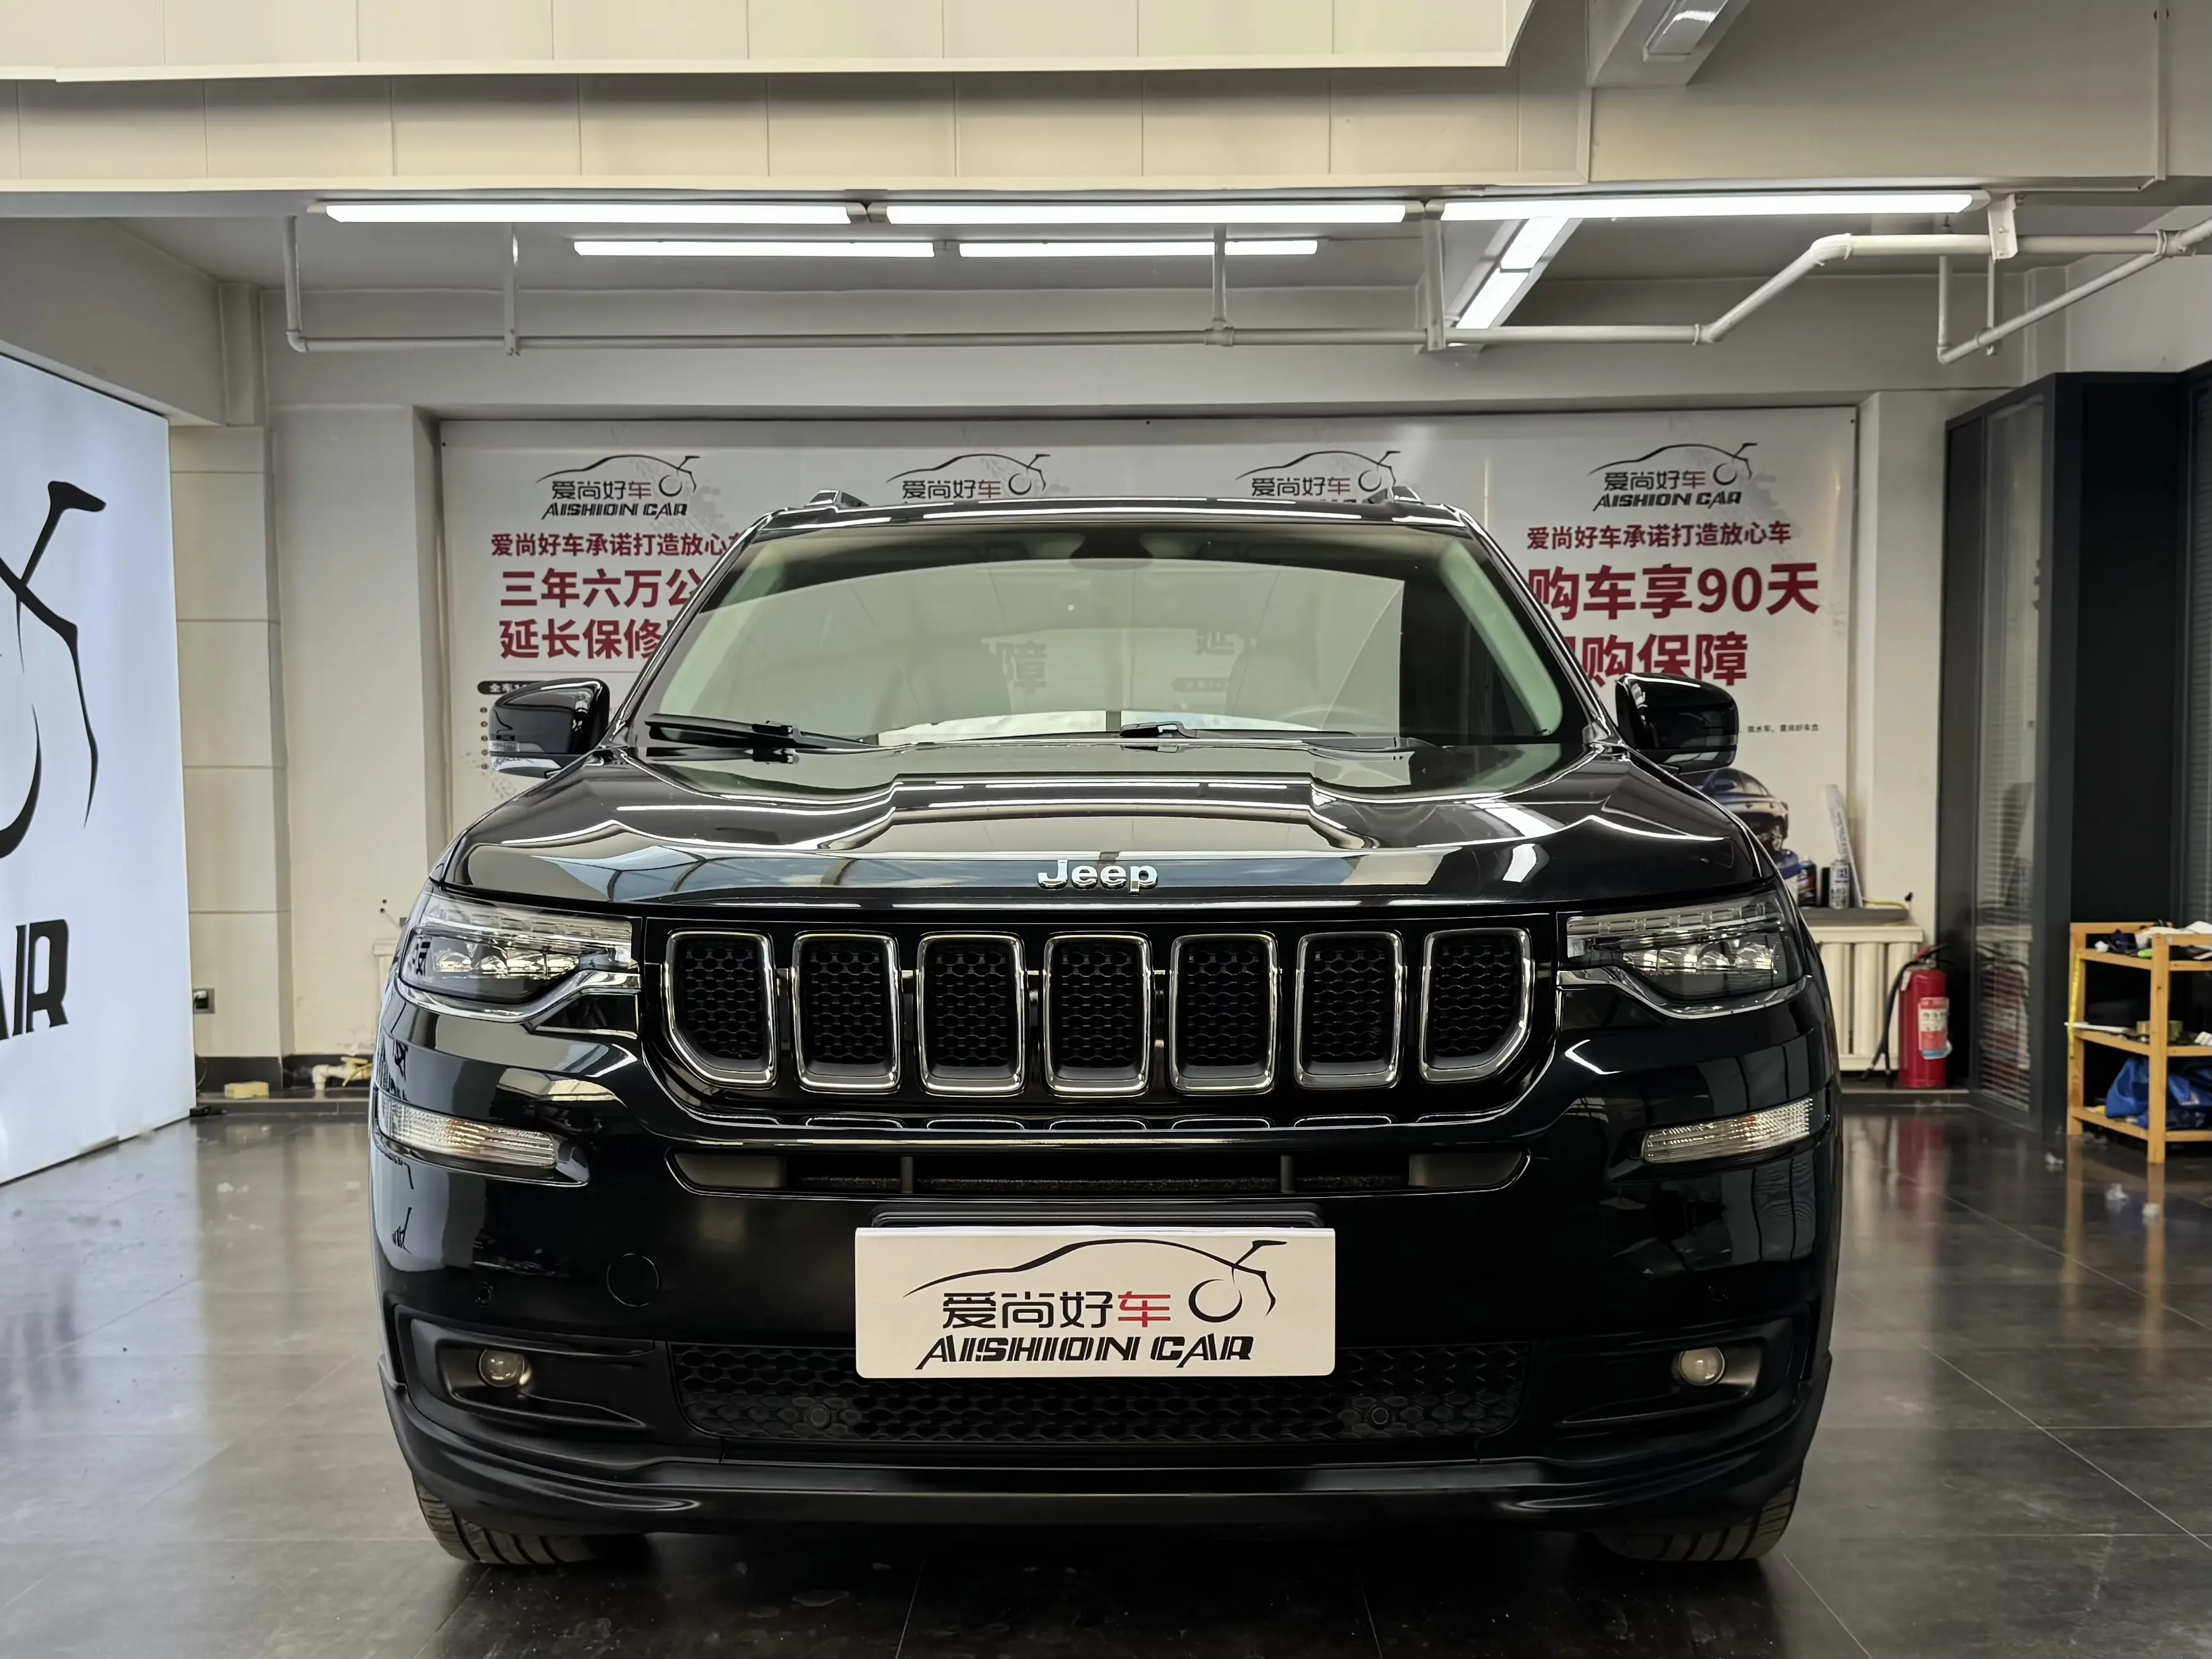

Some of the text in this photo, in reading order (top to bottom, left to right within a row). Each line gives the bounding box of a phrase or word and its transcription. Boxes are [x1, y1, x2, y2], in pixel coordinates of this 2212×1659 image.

[552, 480, 652, 500] 爱尚好车
[902, 479, 1001, 499] 爱尚好车
[1252, 477, 1351, 496] 爱尚好车
[1604, 470, 1706, 491] 爱尚好车
[541, 502, 688, 520] AISHION CAR
[1592, 490, 1743, 512] AISHION CAR
[491, 530, 740, 557] 爱尚好车承诺打造放心
[1527, 520, 1792, 550] 爱尚好车承诺打造放心车
[1529, 562, 1820, 621] 购车享90天
[499, 618, 674, 659] 延长保修
[1564, 631, 1748, 688] 购保障
[1038, 859, 1158, 894] Jeep
[942, 1291, 1171, 1329] 爱尚好车
[914, 1333, 1255, 1370] AISHION CAR
